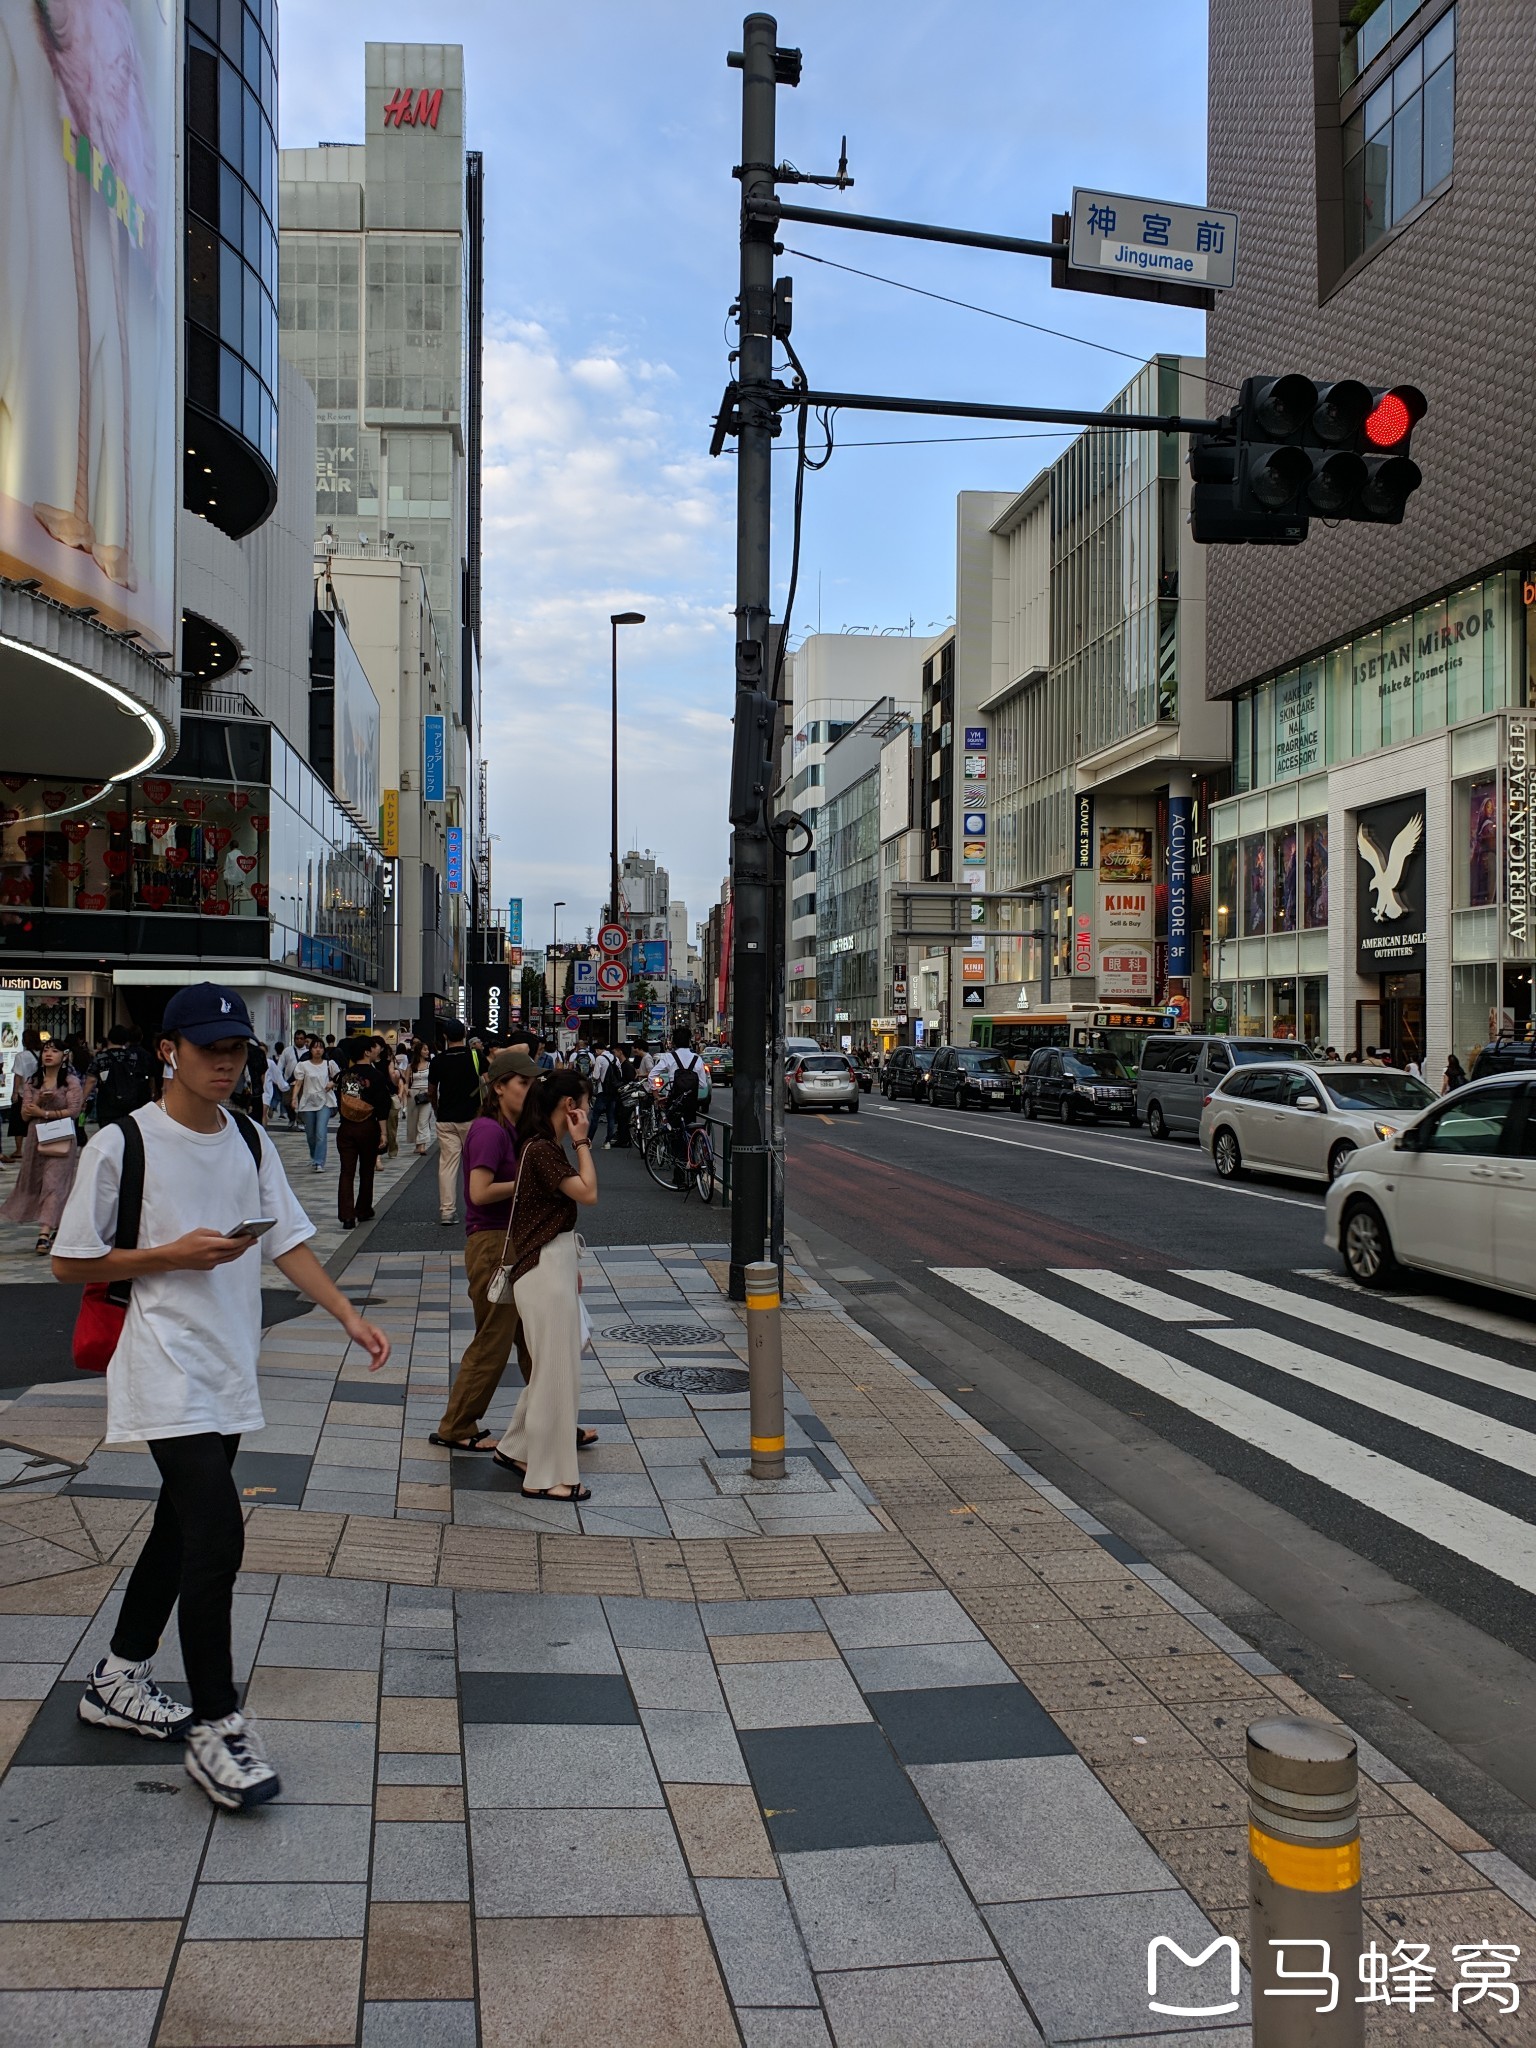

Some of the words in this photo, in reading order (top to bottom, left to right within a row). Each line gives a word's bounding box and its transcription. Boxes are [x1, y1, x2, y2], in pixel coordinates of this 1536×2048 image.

[384, 88, 443, 130] H&M
[63, 116, 145, 249] LAFORET
[1087, 203, 1225, 254] 神宮前
[1115, 245, 1193, 272] Jingumae
[327, 412, 351, 420] Resort
[1524, 581, 1536, 605] b
[1353, 643, 1410, 685] ISETAN
[1378, 679, 1402, 697] Make
[1403, 675, 1412, 688] &
[1413, 656, 1463, 684] Cosmetics
[1282, 687, 1301, 704] MAKE
[1303, 681, 1312, 695] UP
[1280, 705, 1296, 722] SKIN
[1297, 697, 1315, 715] CARE
[1289, 719, 1305, 735] NAL
[434, 732, 442, 762] アリシア
[1277, 730, 1318, 757] FRAGRANCE
[1277, 748, 1317, 772] ACCESSORY
[1509, 724, 1527, 802] EAGLE
[427, 755, 435, 793] クリニック
[1080, 797, 1090, 836] ACUVUE
[449, 832, 458, 889] カラオケ館
[1080, 839, 1089, 867] STORE
[1172, 814, 1186, 881] ACUVUE
[1509, 809, 1526, 943] AMERICAN
[1105, 895, 1146, 911] KINJI
[1172, 888, 1185, 936] STORE
[1129, 920, 1141, 928] Buy
[604, 932, 621, 946] 50
[1077, 932, 1091, 972] WEGO
[1171, 947, 1185, 957] 3F
[1361, 935, 1401, 949] AMERICAN
[1402, 932, 1427, 946] EAGLE
[1374, 946, 1413, 958] OUTFITTERS
[578, 963, 592, 980] P
[1108, 958, 1141, 971] 眼科
[33, 977, 62, 990] Davis
[486, 986, 500, 1034] Galaxy
[584, 996, 596, 1005] IN
[1167, 1006, 1172, 1015] P
